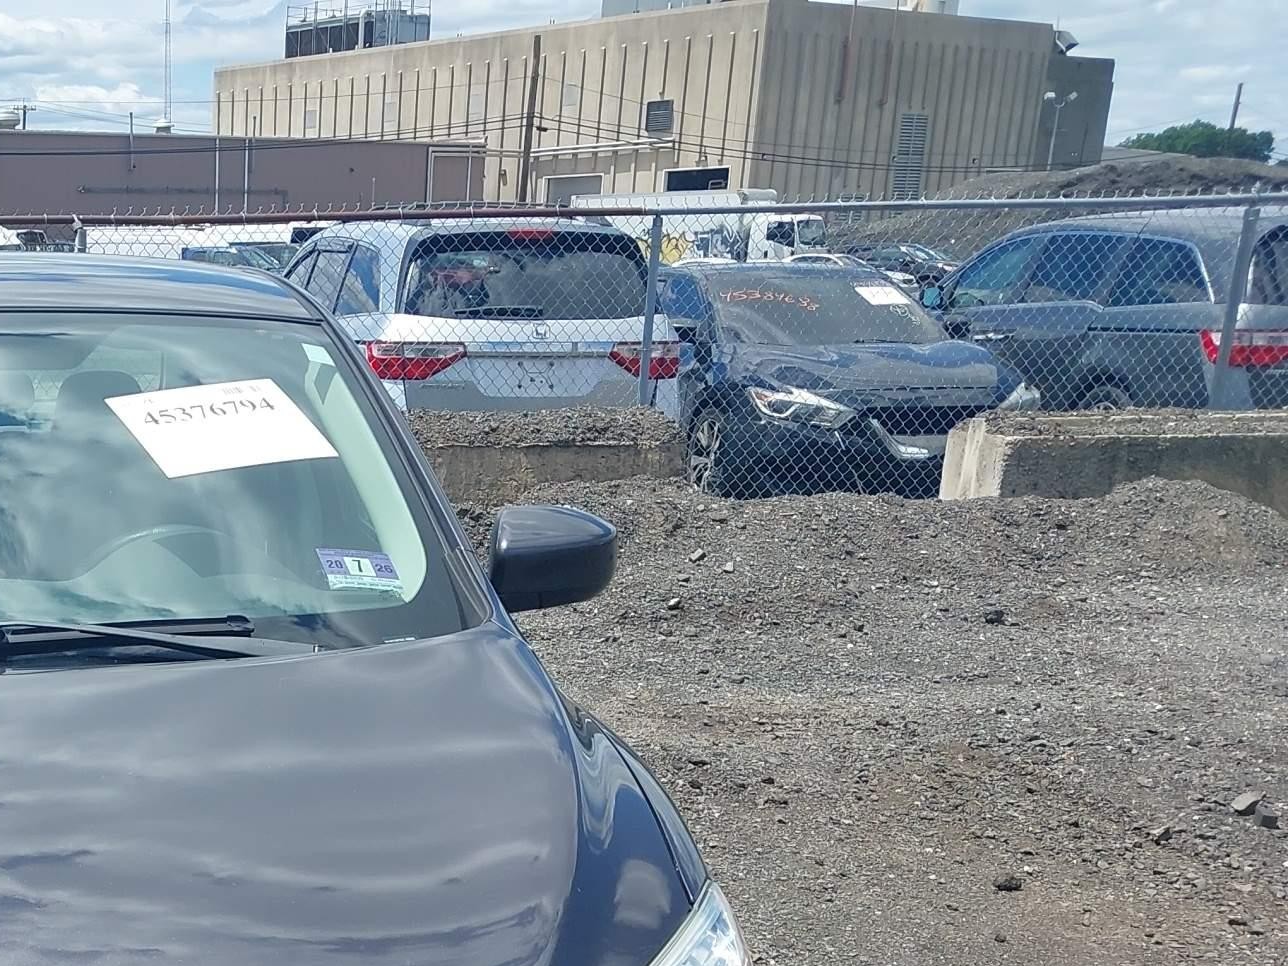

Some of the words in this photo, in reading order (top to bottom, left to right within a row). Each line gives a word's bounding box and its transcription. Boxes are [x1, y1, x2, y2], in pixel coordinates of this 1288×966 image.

[144, 397, 275, 426] 45376794
[326, 559, 344, 569] 20
[351, 559, 364, 574] 7
[374, 563, 394, 574] 26
